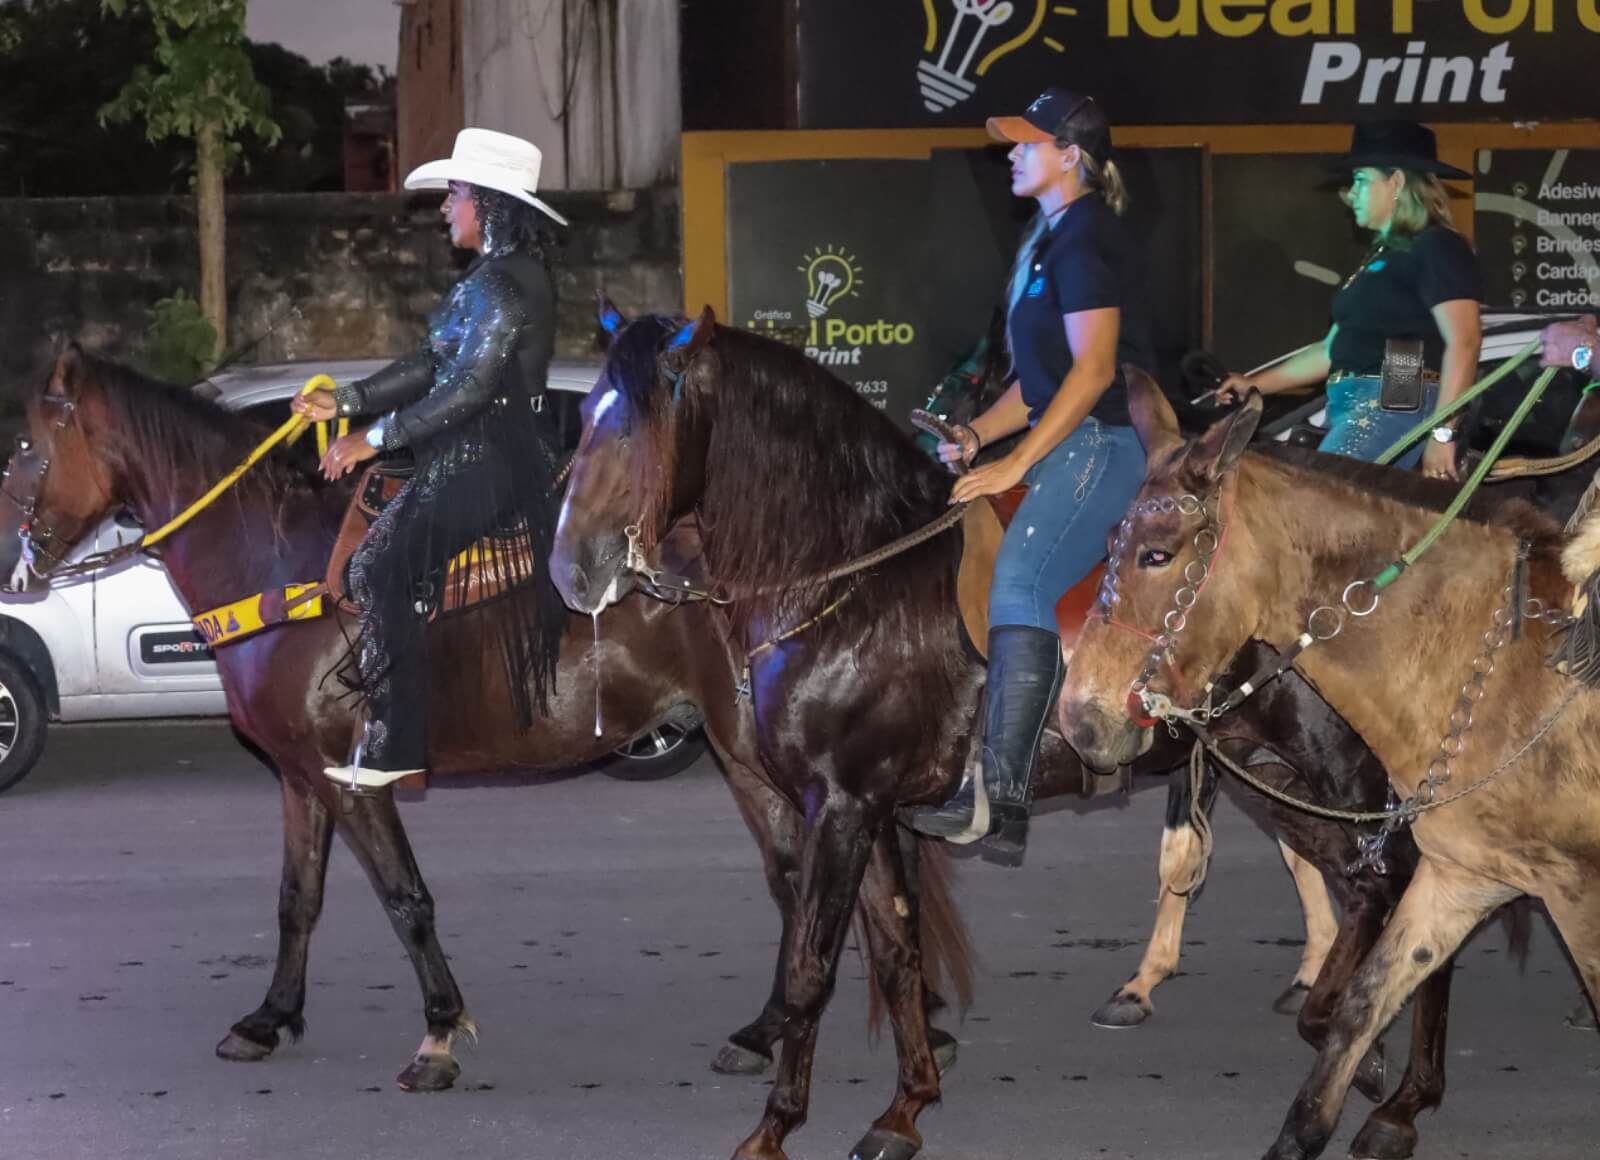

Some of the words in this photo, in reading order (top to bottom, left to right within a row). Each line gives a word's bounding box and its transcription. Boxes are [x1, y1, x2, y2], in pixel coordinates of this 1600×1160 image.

[1300, 41, 1514, 104] Print
[754, 310, 792, 320] Gráfica
[826, 318, 914, 346] Porto
